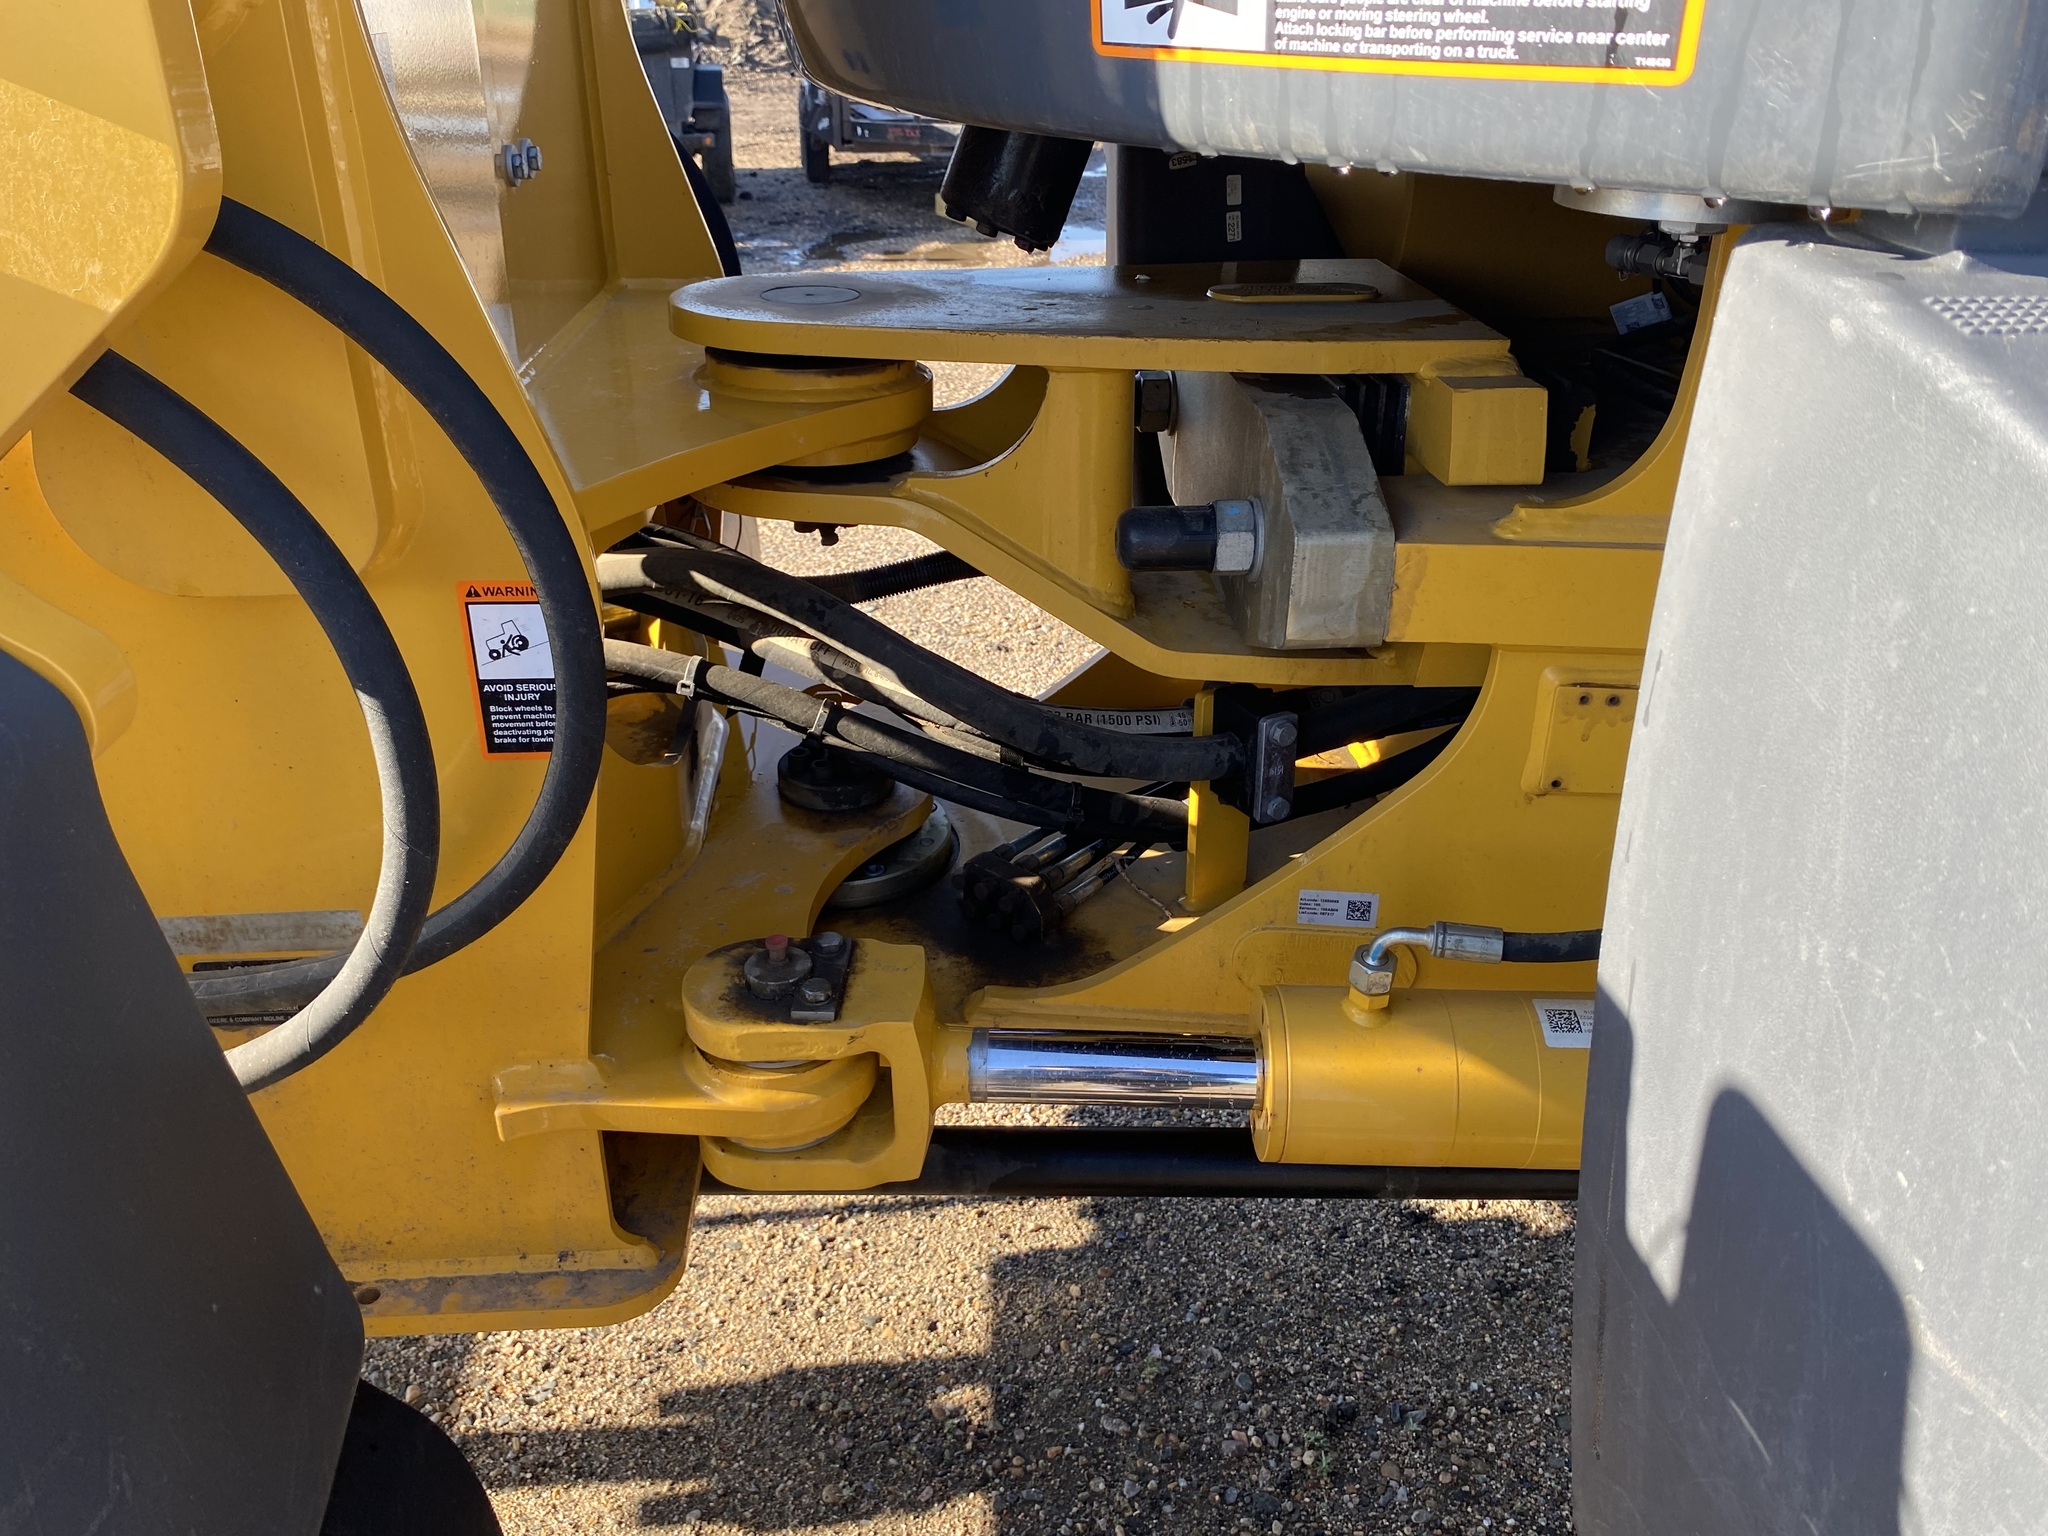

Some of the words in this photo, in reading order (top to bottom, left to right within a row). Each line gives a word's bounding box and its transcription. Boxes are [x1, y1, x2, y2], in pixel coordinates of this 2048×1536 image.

[1275, 6, 1316, 22] engine
[1318, 9, 1333, 20] or
[1334, 7, 1383, 24] moving
[1385, 8, 1441, 26] steering
[1443, 9, 1489, 23] wheel.
[1274, 21, 1314, 35] Attach
[1316, 22, 1362, 40] locking
[1364, 24, 1387, 38] bar
[1389, 25, 1433, 39] before
[1435, 26, 1515, 45] performing
[1518, 28, 1574, 43] service
[1576, 32, 1614, 44] near
[1615, 30, 1670, 46] center
[1274, 37, 1288, 50] of
[1289, 38, 1340, 53] machine
[1342, 42, 1358, 53] or
[1359, 41, 1440, 59] transporting
[1443, 46, 1462, 57] on
[1464, 47, 1475, 58] a
[1477, 45, 1519, 59] truck.
[482, 586, 538, 597] WARNIN
[483, 684, 514, 692] AVOID
[504, 693, 541, 701] INJURY
[491, 713, 522, 721] prevent
[1097, 713, 1132, 726] (1500
[1135, 714, 1161, 726] PSI)
